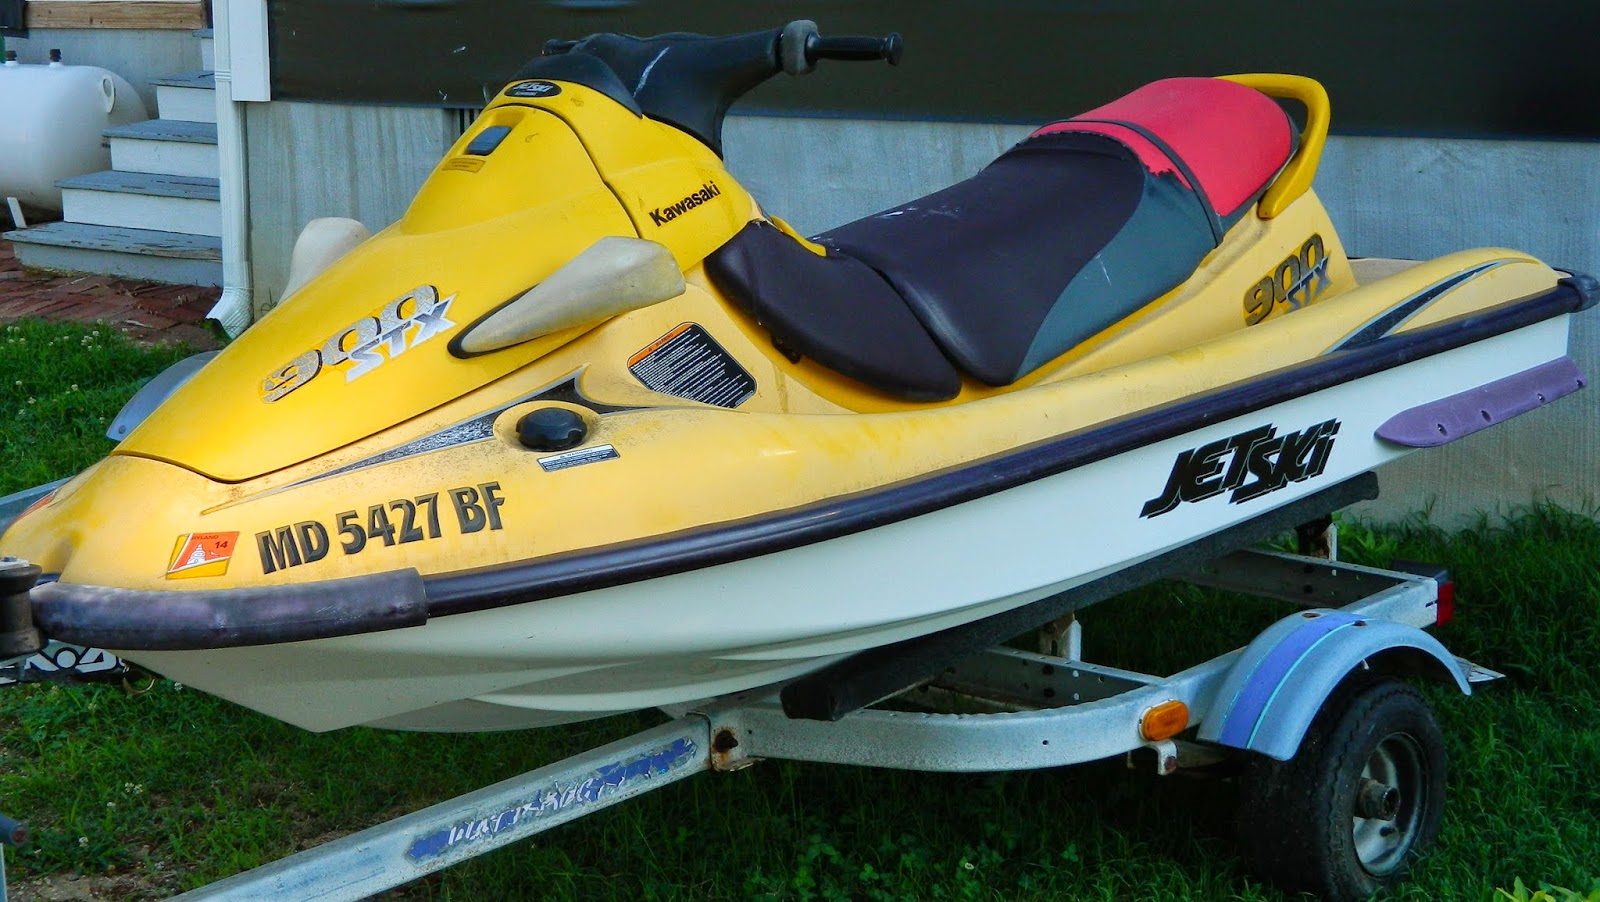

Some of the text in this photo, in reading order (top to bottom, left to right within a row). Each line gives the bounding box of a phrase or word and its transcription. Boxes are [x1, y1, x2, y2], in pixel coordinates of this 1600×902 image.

[649, 180, 721, 227] Kawasaki
[1243, 233, 1325, 327] 900
[1286, 253, 1332, 314] STX
[261, 284, 440, 403] 900
[345, 293, 458, 384] STX
[214, 540, 229, 549] 14
[254, 481, 505, 575] MD 5427 BF
